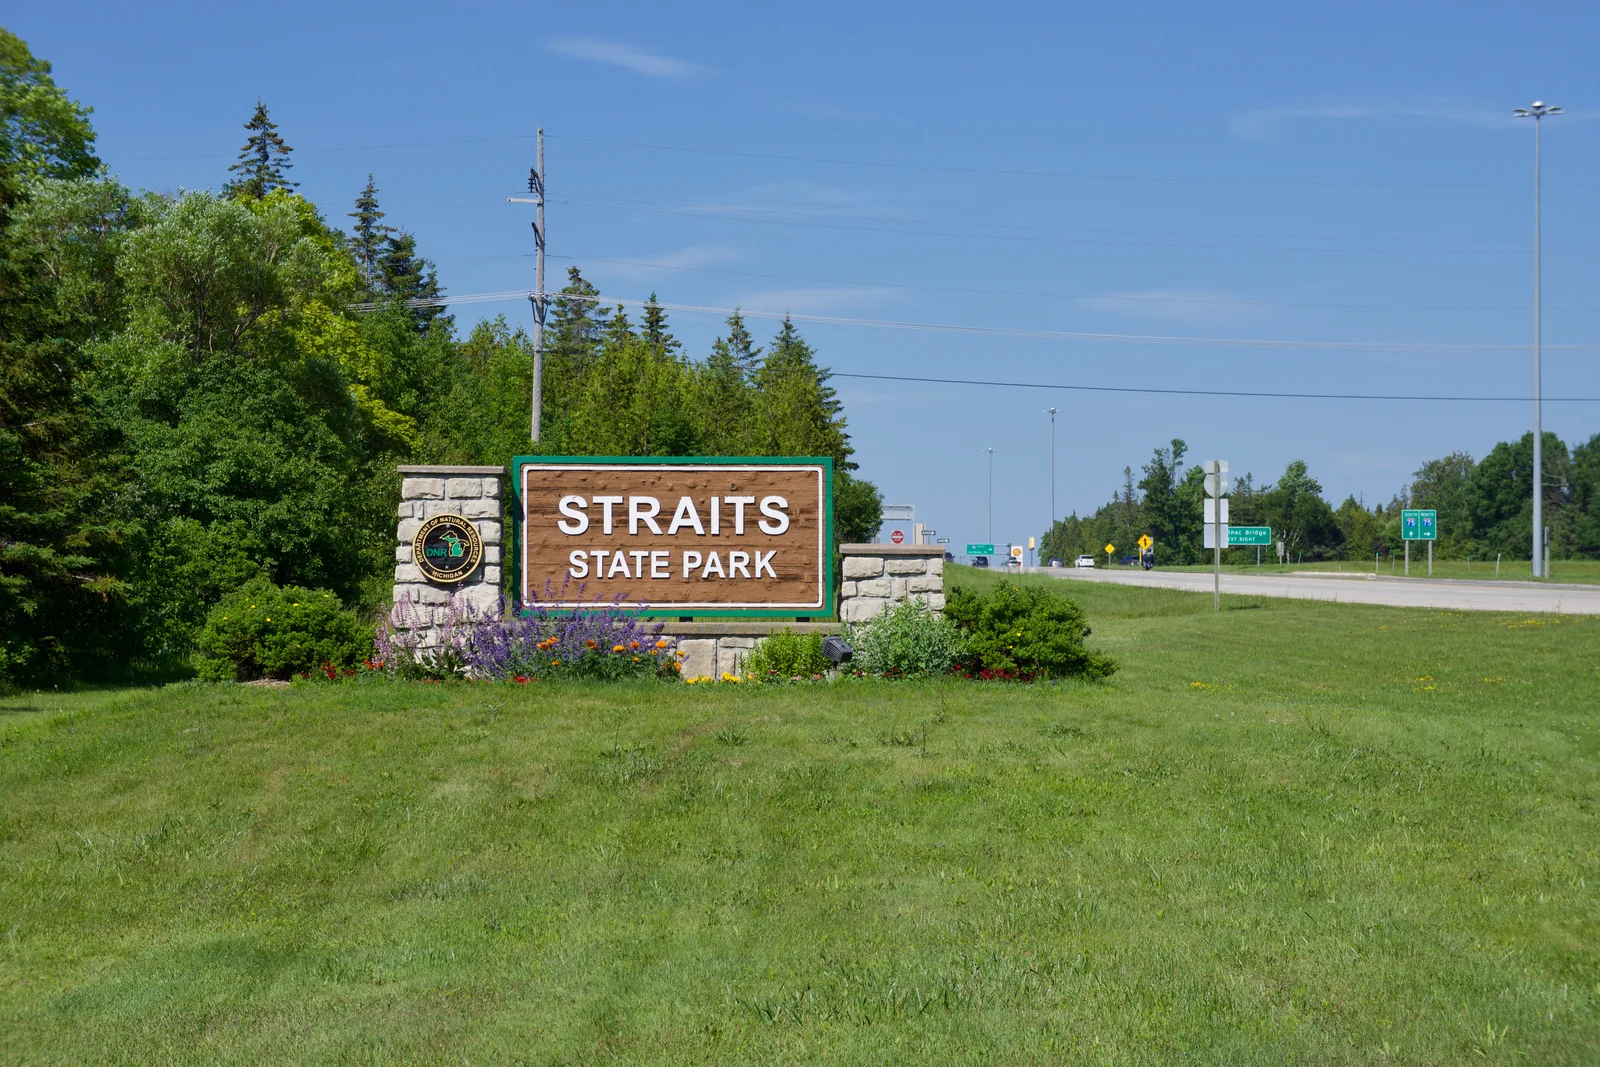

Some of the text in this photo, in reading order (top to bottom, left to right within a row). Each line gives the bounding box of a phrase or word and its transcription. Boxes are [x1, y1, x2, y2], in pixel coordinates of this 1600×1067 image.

[557, 495, 790, 536] STRAITS
[415, 516, 479, 563] DEPARTMENT OF NATURAL RESOURCES
[426, 548, 448, 557] DNR
[431, 570, 463, 579] MICHIGAN
[568, 550, 778, 579] STATE PARK
